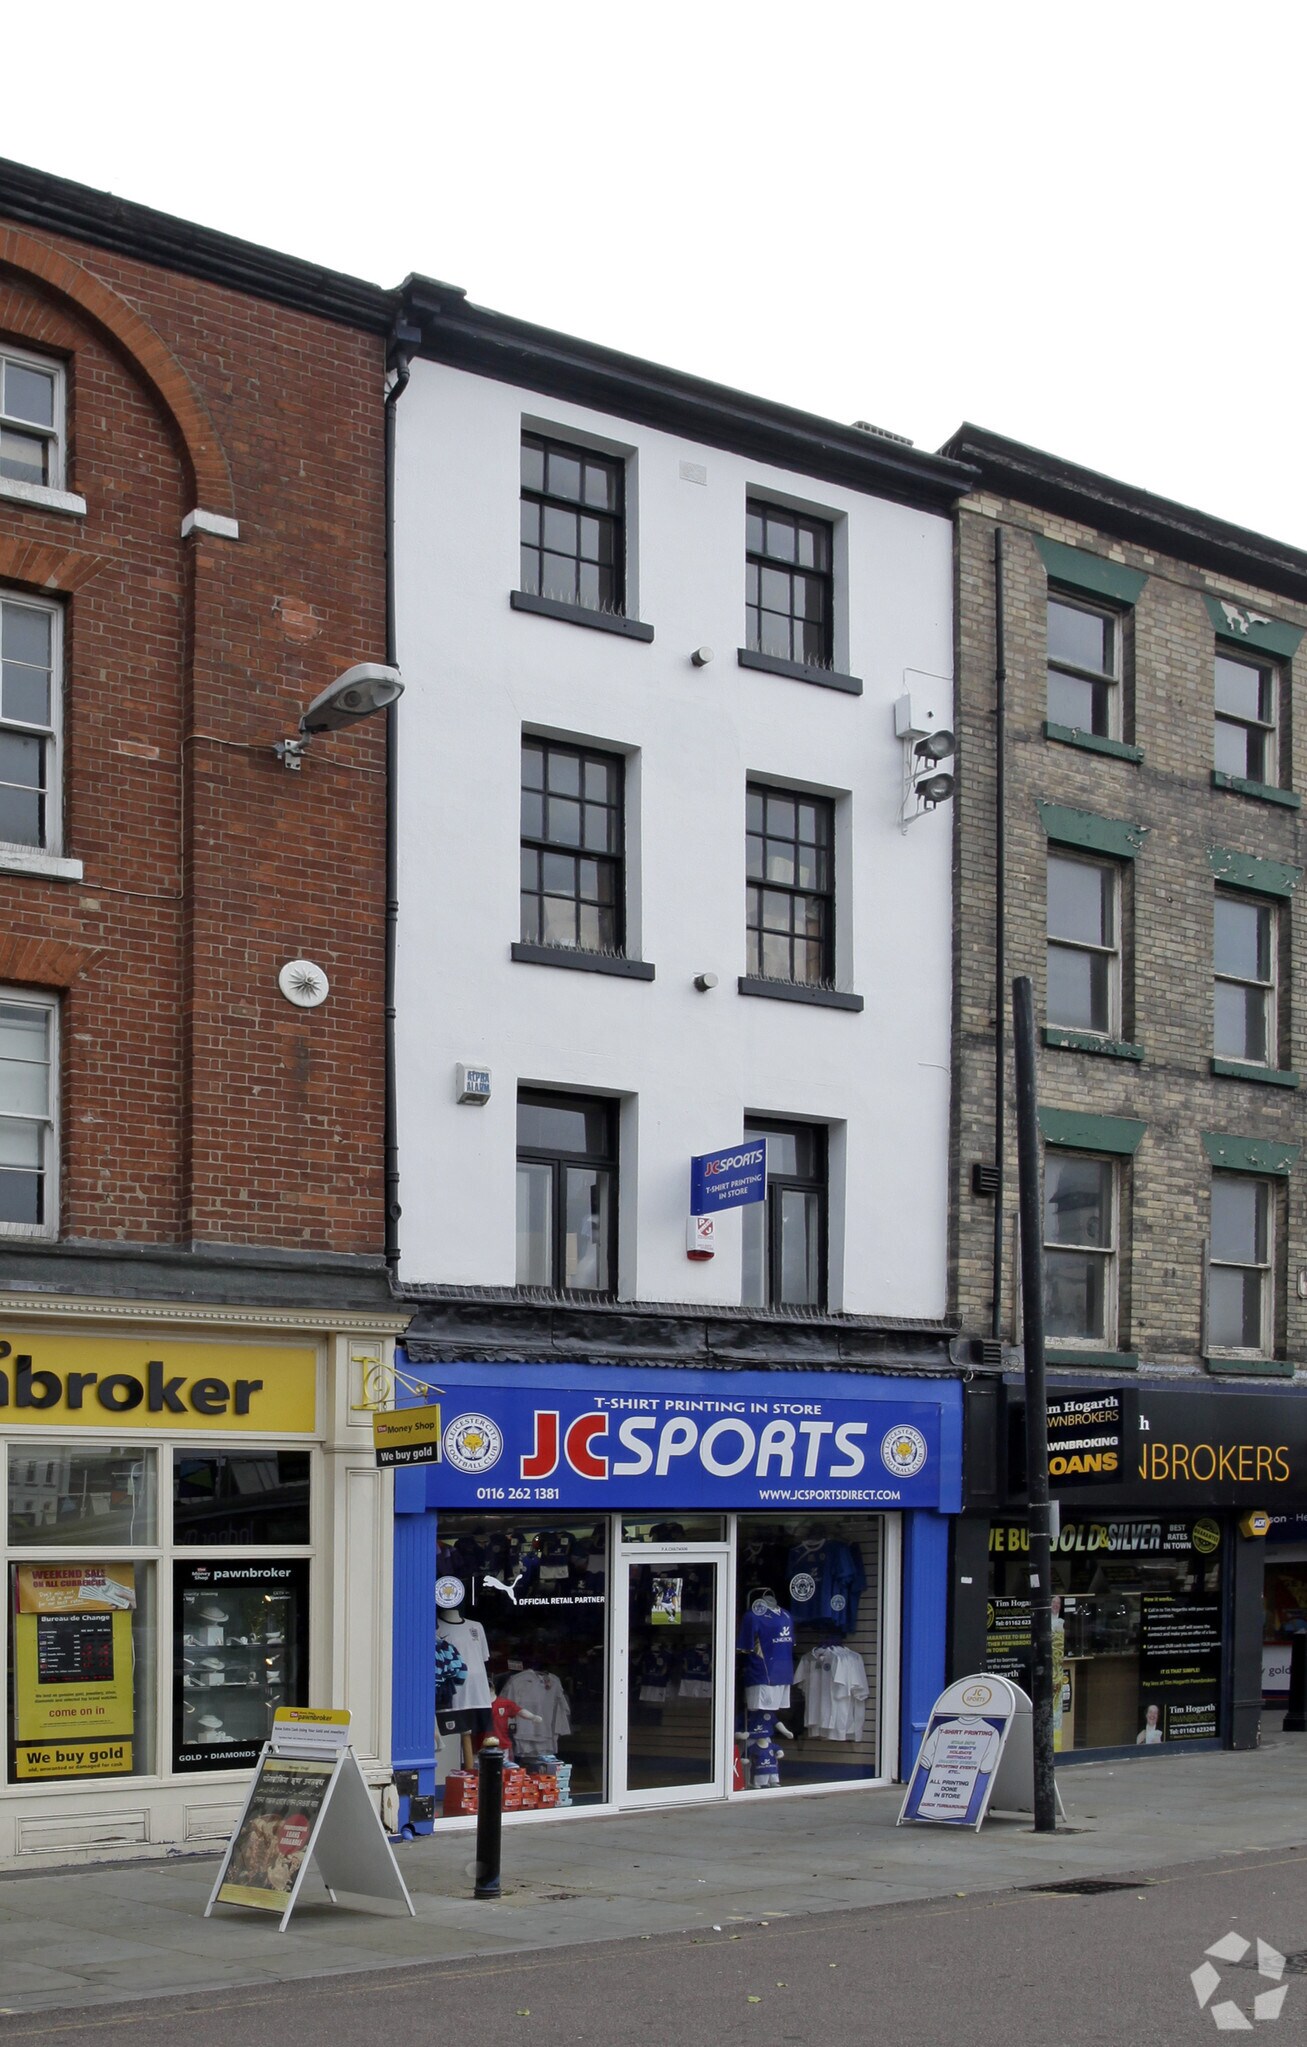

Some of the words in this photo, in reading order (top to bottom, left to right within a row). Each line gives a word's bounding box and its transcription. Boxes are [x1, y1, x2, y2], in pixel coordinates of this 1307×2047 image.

[706, 1182, 729, 1194] T-SHIRT
[730, 1174, 762, 1188] PRINTING
[719, 1192, 727, 1200] IN
[728, 1187, 748, 1198] STORE
[0, 1354, 263, 1415] broker
[594, 1397, 660, 1410] T-SHIRT
[665, 1400, 745, 1413] PRINTING
[751, 1403, 768, 1414] IN
[772, 1403, 822, 1415] STORE
[1046, 1403, 1061, 1414] im
[1063, 1395, 1119, 1413] Hogarth
[388, 1424, 413, 1433] Money
[415, 1422, 434, 1431] Shop
[381, 1452, 394, 1461] We
[395, 1450, 411, 1461] buy
[413, 1446, 432, 1460] gold
[448, 1444, 483, 1468] FOOTBALL
[1048, 1452, 1118, 1475] OANS
[476, 1487, 505, 1500] 0116
[507, 1487, 531, 1500] 262
[534, 1487, 559, 1500] 1381
[759, 1489, 901, 1500] WWW.JCSPORTSDIRECT.COM
[1008, 1528, 1030, 1551] BU
[1167, 1532, 1188, 1541] RATES
[1170, 1541, 1192, 1550] TOWN
[32, 1569, 82, 1579] WEEKEND
[84, 1569, 105, 1578] SALE
[213, 1568, 291, 1580] pawnbroker
[60, 1579, 106, 1587] CURRENCIES
[519, 1597, 550, 1606] OFFICIAL
[550, 1597, 574, 1605] RETAIL
[574, 1596, 605, 1604] PARTNER
[81, 1614, 110, 1622] Change
[49, 1708, 77, 1717] come
[79, 1707, 92, 1716] on
[96, 1706, 105, 1715] in
[1169, 1706, 1184, 1714] Tim
[1185, 1703, 1216, 1713] Hogarth
[26, 1752, 51, 1764] We
[55, 1750, 84, 1764] buy
[89, 1746, 123, 1763] gold
[179, 1754, 202, 1762] GOLD
[210, 1750, 256, 1760] DIAMONDS
